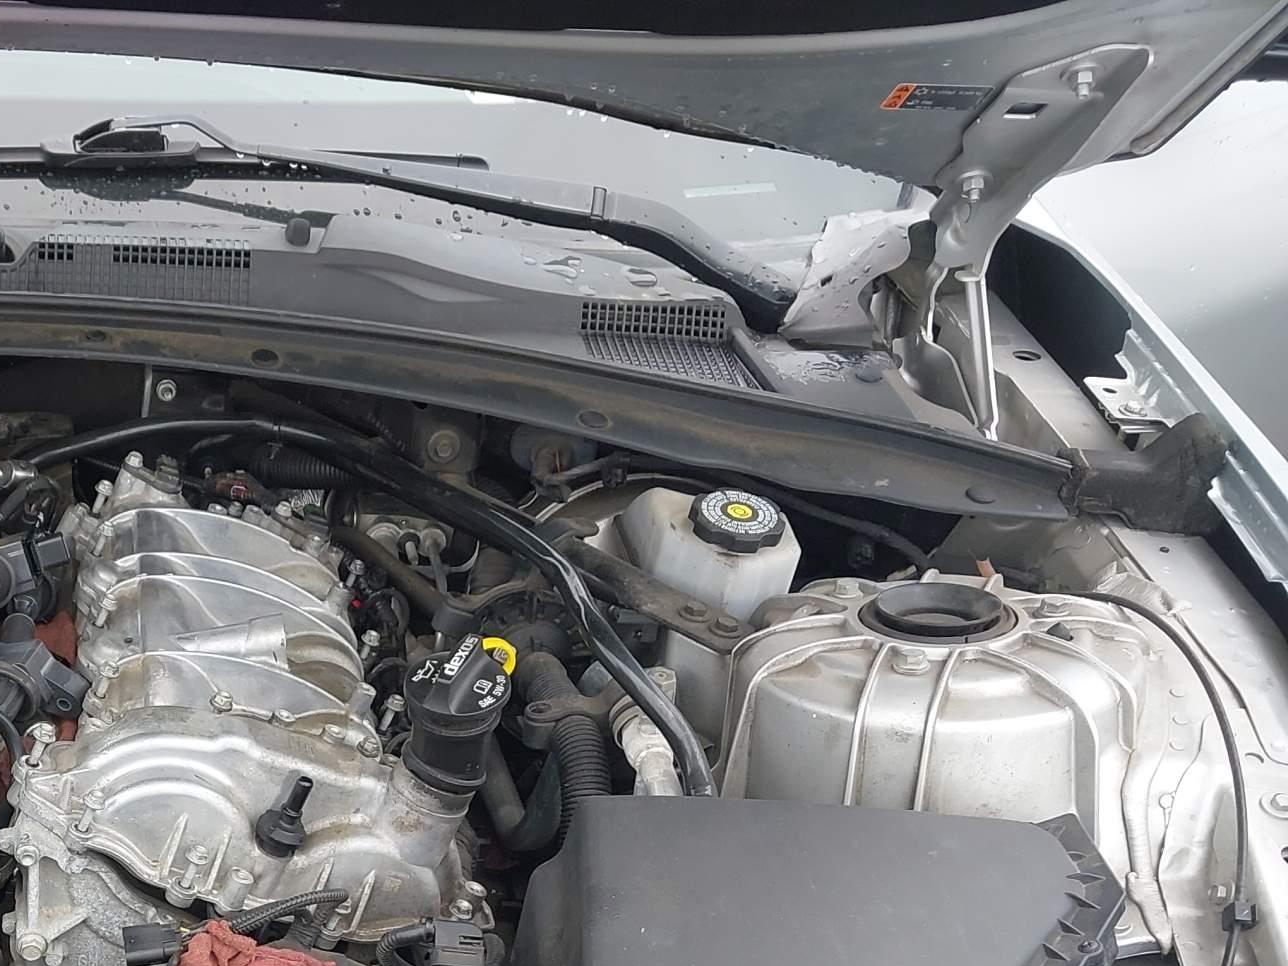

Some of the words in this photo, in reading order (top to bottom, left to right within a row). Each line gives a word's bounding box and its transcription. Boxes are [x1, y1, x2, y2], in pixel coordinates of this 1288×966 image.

[443, 636, 479, 676] dexos
[478, 695, 497, 708] SAE
[492, 674, 507, 697] 5W-30
